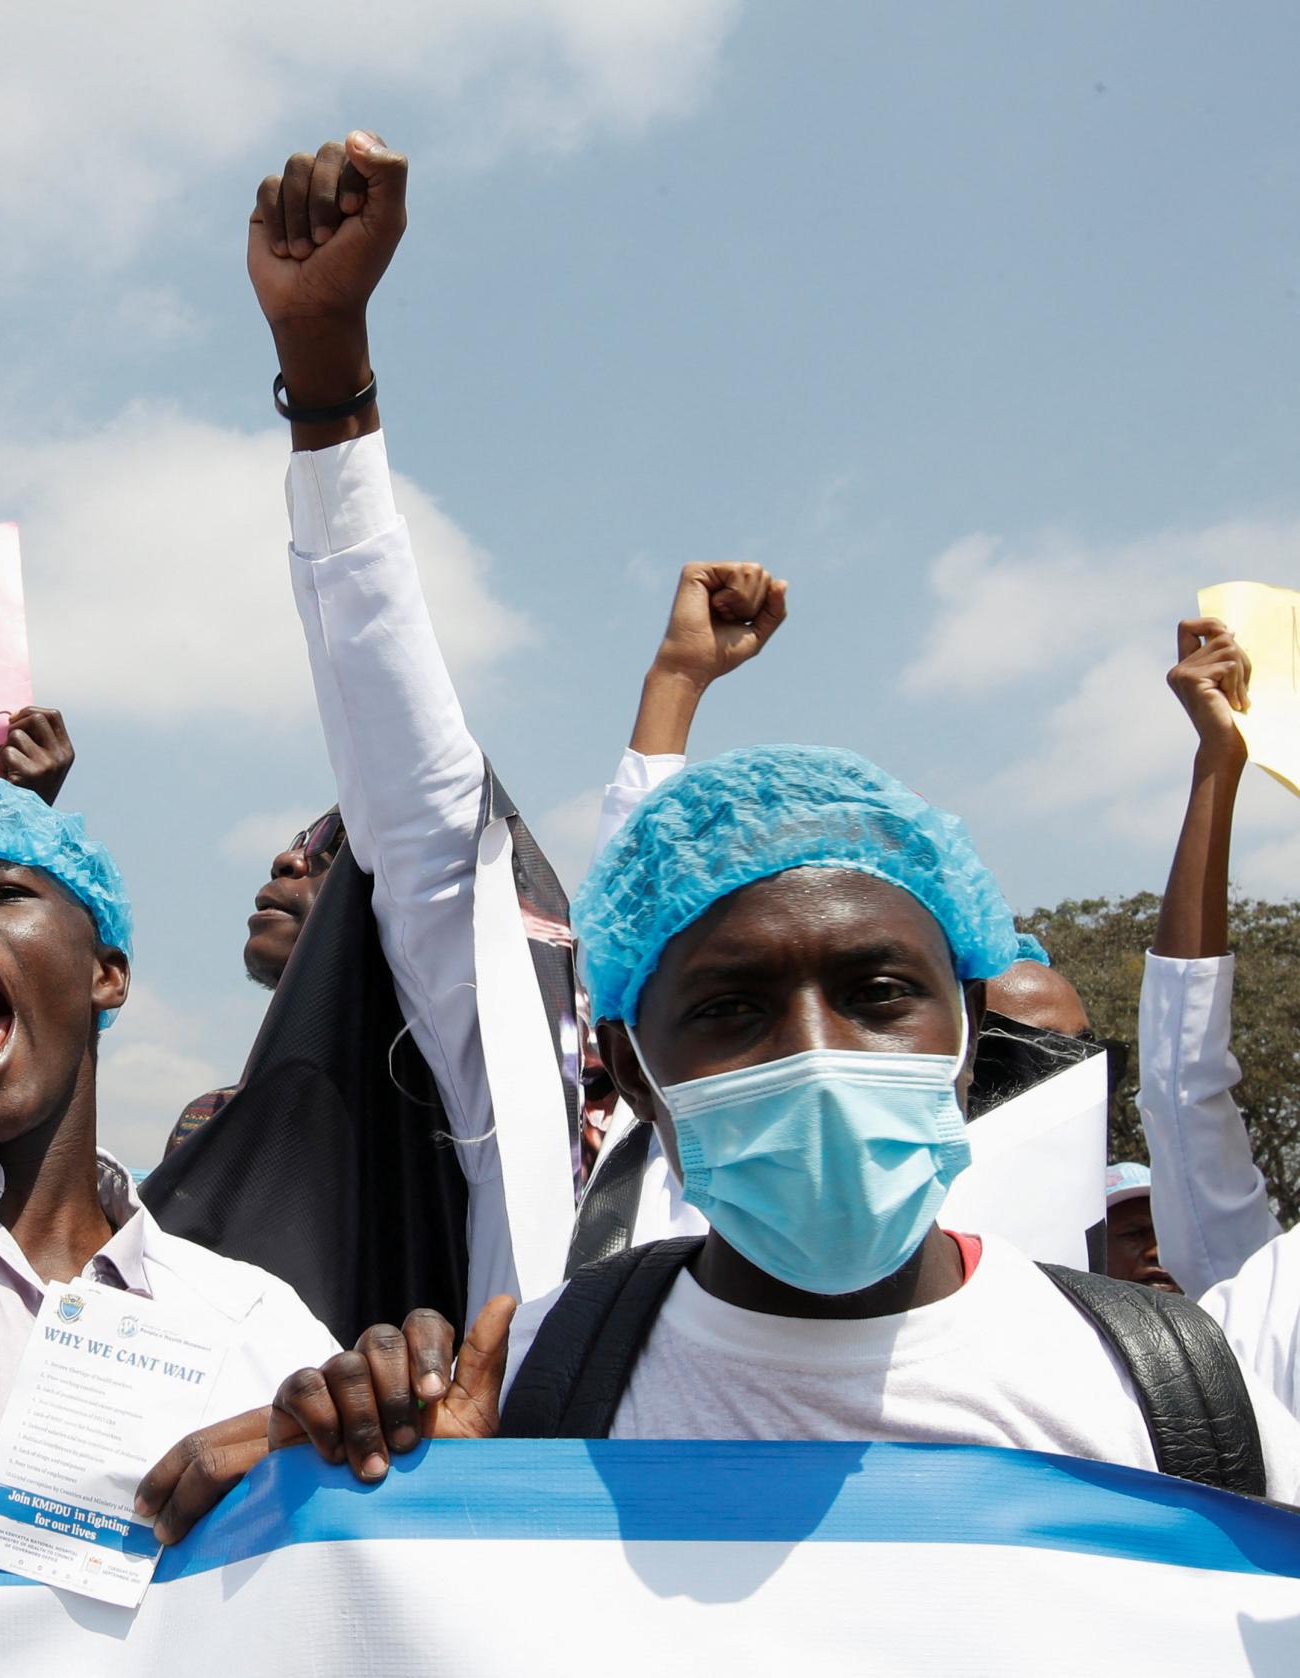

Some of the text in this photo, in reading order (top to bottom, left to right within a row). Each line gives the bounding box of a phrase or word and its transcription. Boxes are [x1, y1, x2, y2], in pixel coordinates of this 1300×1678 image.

[44, 1326, 206, 1385] WHY WE CANT WAIT
[8, 1490, 131, 1536] Join KMPDU in fighting
[34, 1513, 98, 1541] for our lives
